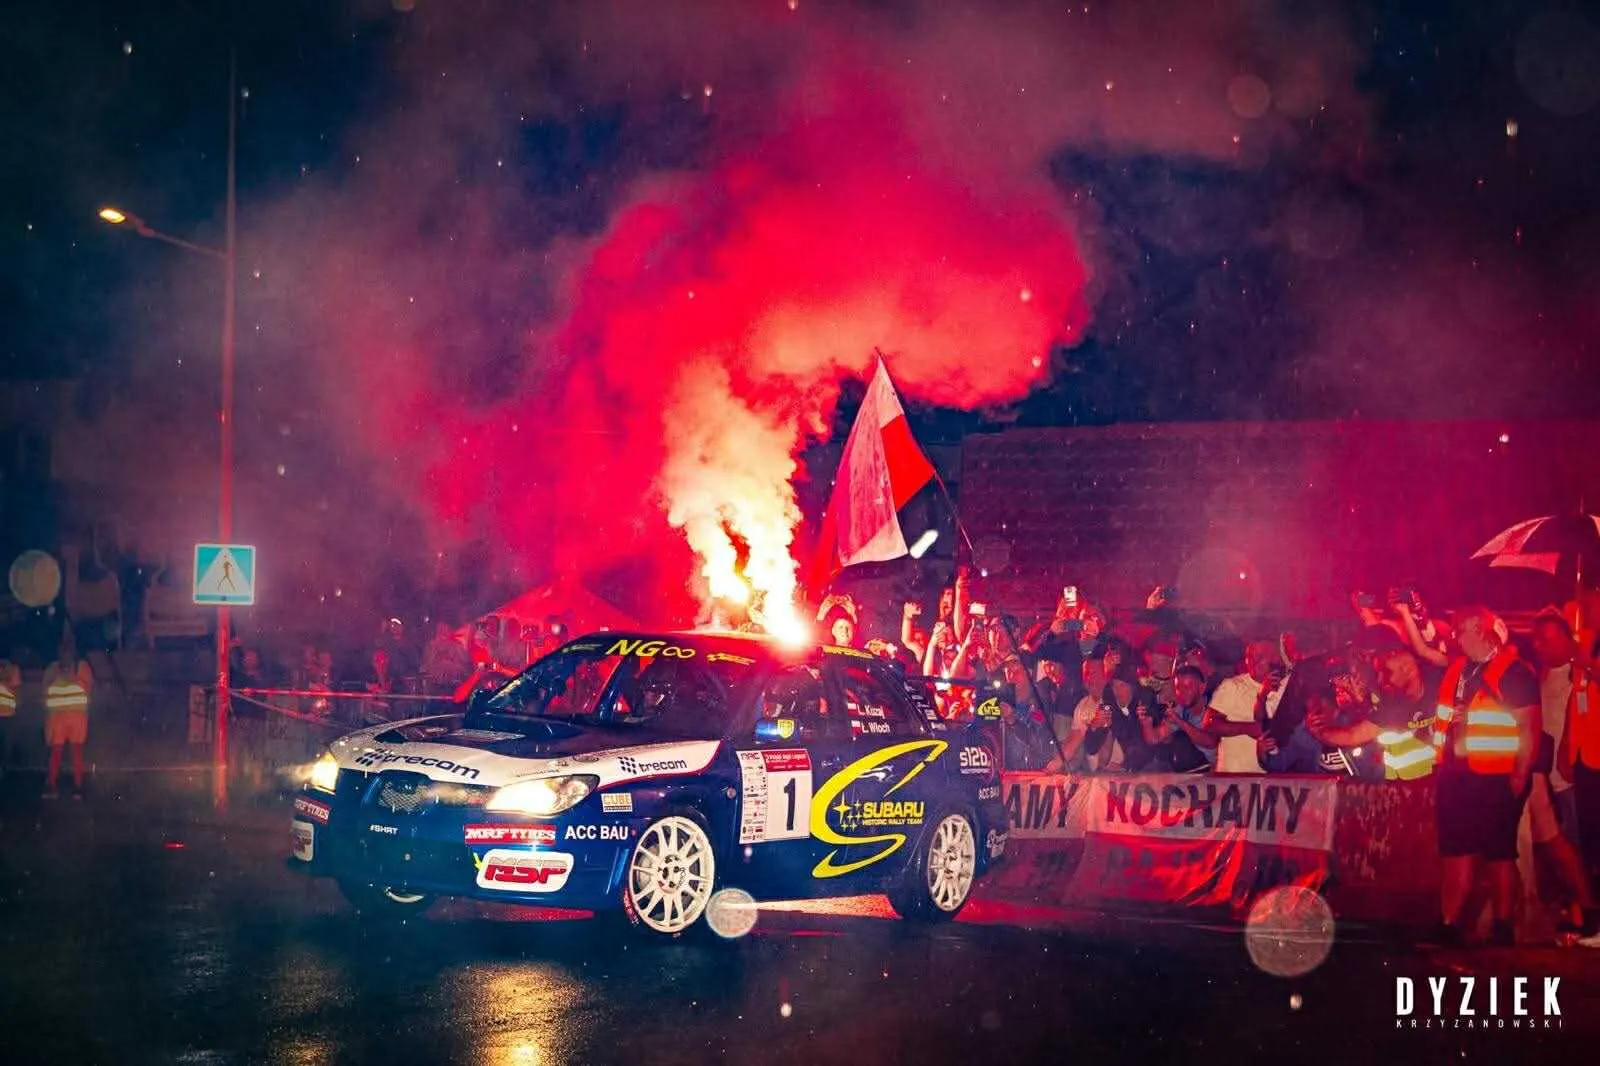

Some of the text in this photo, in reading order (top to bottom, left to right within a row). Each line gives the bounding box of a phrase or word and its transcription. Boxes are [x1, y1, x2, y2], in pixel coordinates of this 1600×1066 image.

[382, 753, 481, 780] trecom
[638, 759, 688, 774] trecom
[783, 777, 796, 832] 1
[863, 801, 924, 819] SUBARU
[1106, 780, 1310, 834] KOCHAMY
[565, 825, 628, 840] ACC BAU
